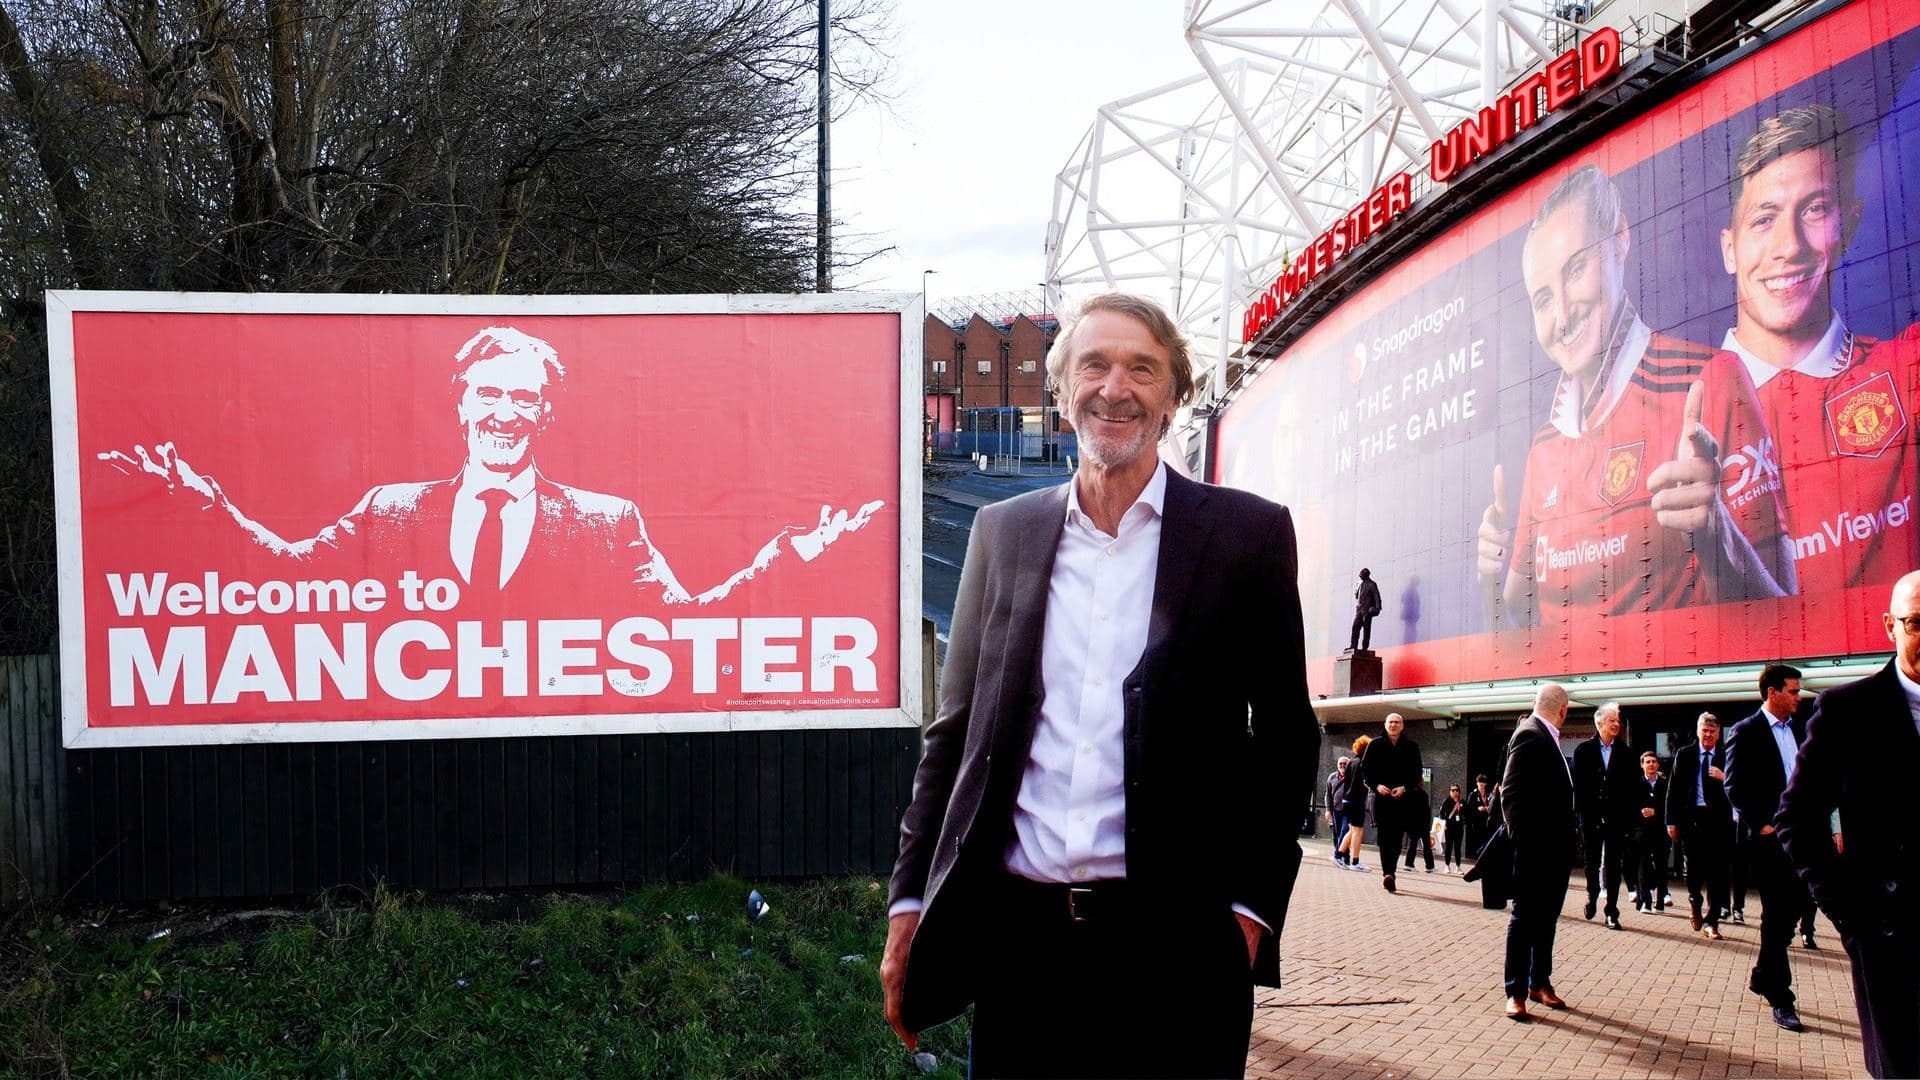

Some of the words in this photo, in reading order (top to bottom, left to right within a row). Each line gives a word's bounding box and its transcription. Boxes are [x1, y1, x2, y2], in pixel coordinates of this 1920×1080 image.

[1243, 172, 1412, 345] MANCHESTER
[1431, 26, 1622, 183] UNITED
[1372, 296, 1465, 361] Snapdragon
[1332, 408, 1349, 438] IN
[1355, 385, 1393, 425] THE
[1402, 338, 1485, 401] FRAME
[1335, 445, 1352, 475] IN
[1359, 424, 1397, 463] THE
[1406, 389, 1477, 441] GAME
[106, 571, 387, 616] Welcome
[398, 570, 461, 611] to
[1548, 534, 1629, 569] TeamViewer
[108, 616, 879, 707] MANCHESTER
